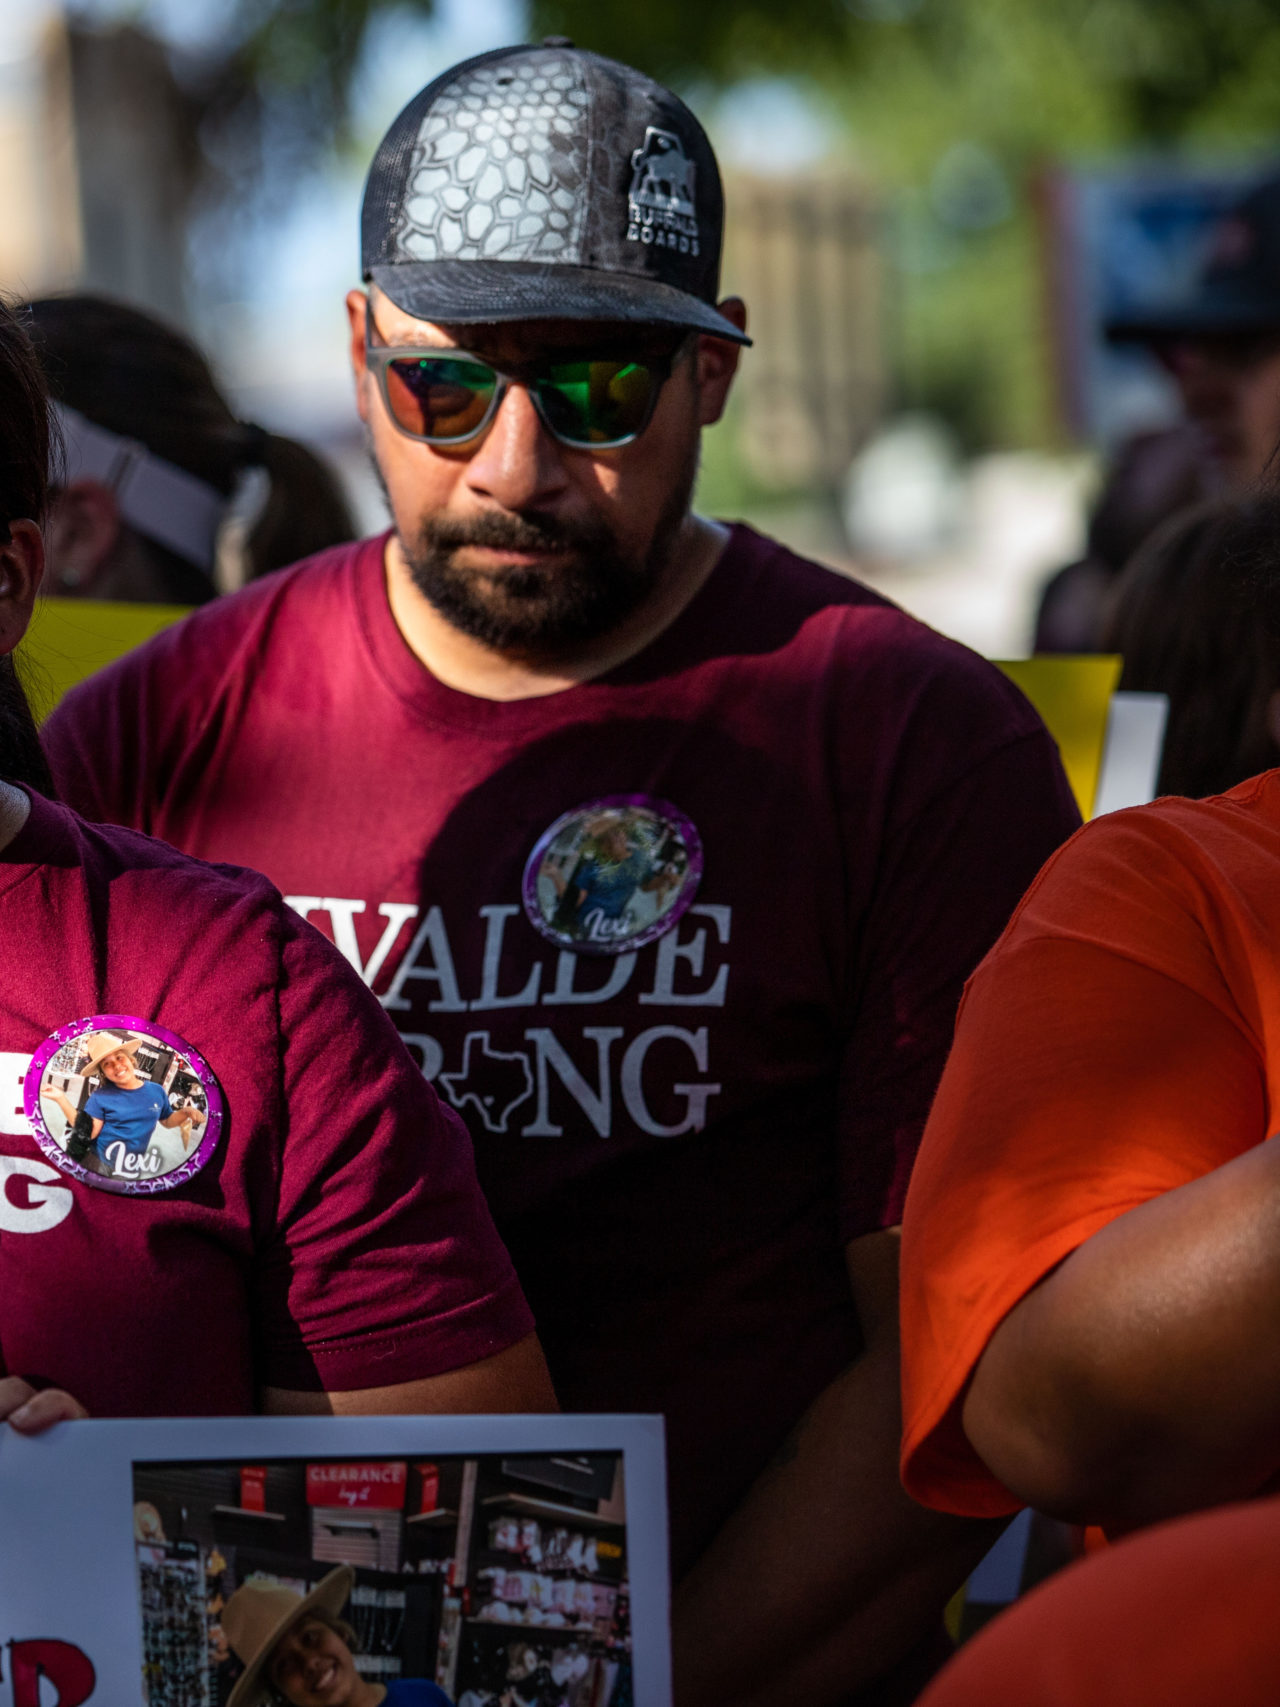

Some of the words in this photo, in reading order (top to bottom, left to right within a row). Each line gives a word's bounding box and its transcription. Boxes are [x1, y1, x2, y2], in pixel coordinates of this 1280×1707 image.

[584, 907, 631, 943] Lexi
[104, 1140, 162, 1179] Lexi
[309, 1465, 401, 1484] CLEARANCE
